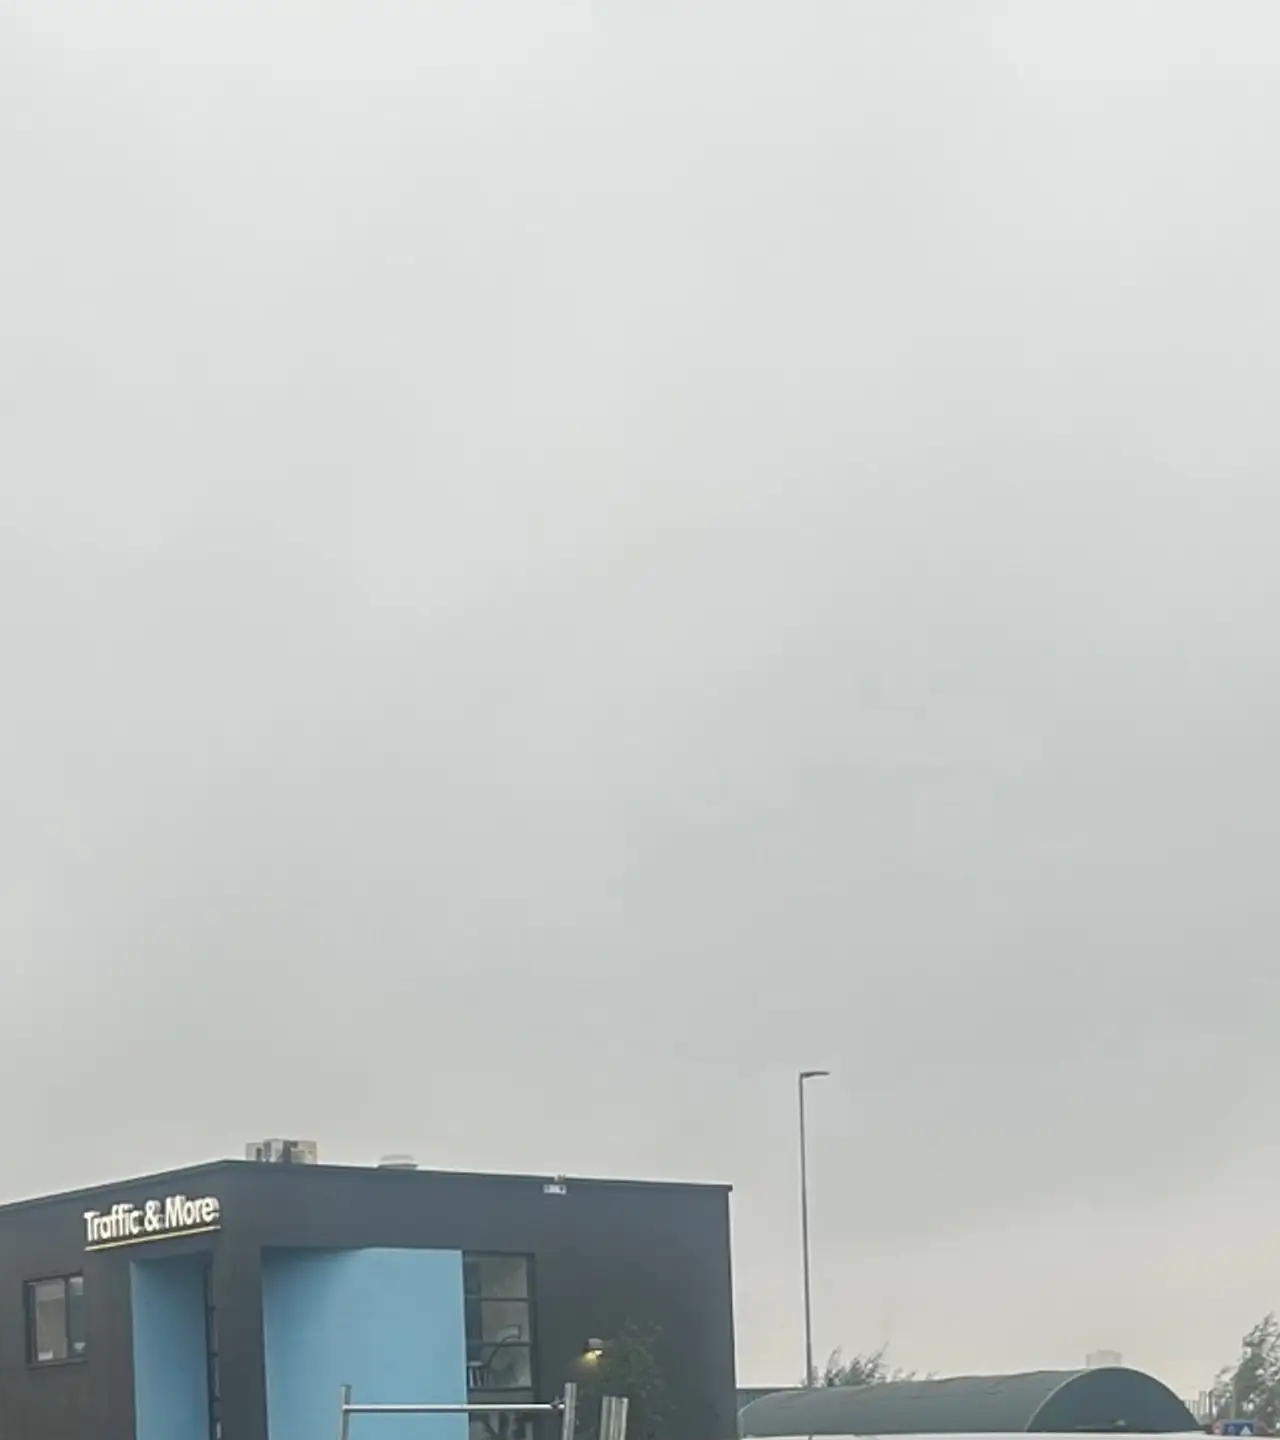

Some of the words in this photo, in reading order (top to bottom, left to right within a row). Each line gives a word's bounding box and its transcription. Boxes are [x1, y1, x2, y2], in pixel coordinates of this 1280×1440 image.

[84, 1203, 142, 1242] Traffic
[144, 1199, 162, 1232] &
[165, 1194, 221, 1229] More
